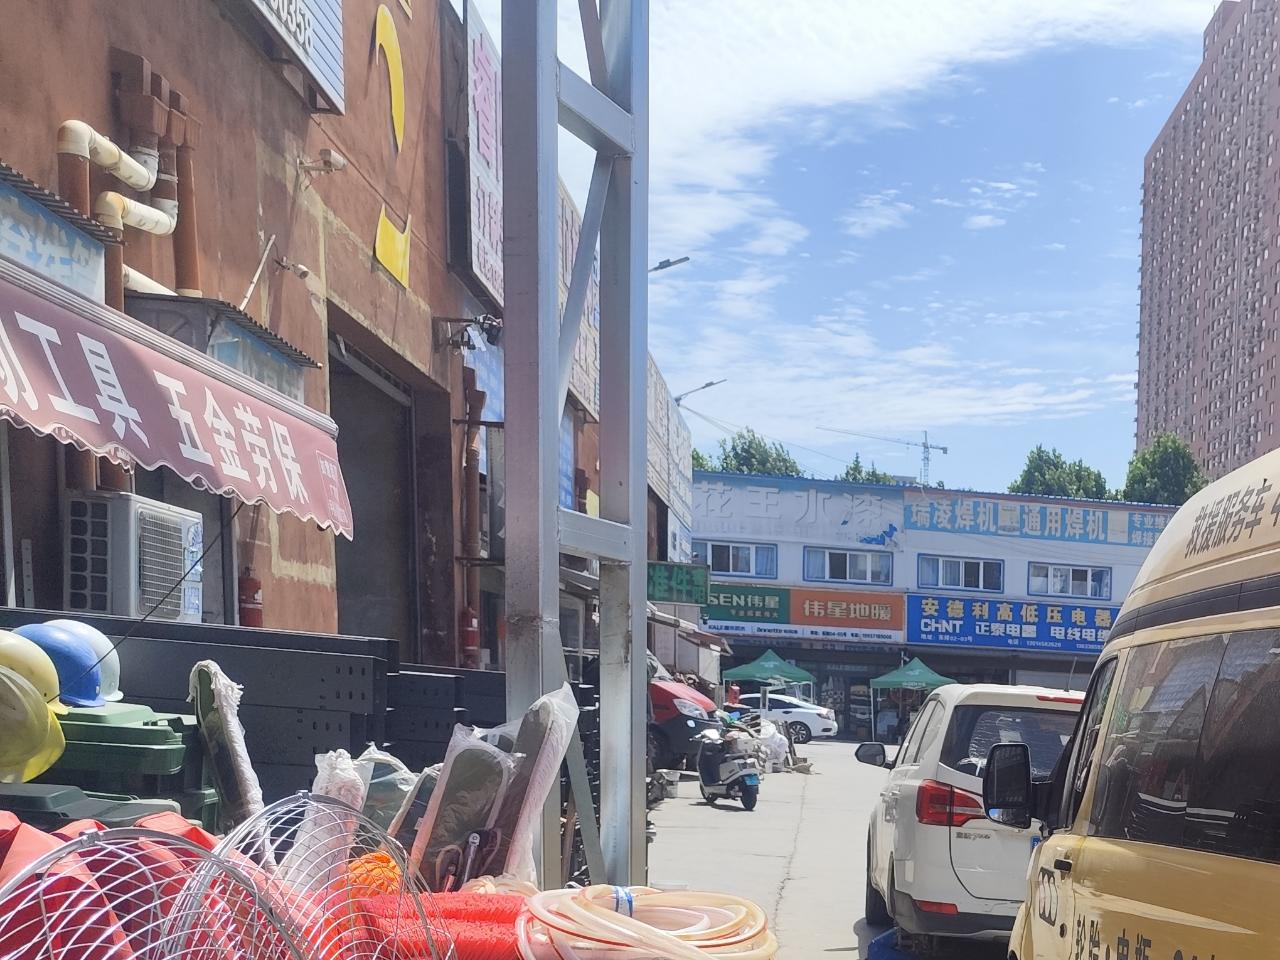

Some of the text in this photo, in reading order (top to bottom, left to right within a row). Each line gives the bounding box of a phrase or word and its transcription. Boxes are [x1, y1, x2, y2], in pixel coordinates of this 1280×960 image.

[270, 0, 313, 50] 0358
[153, 370, 309, 504] 五金劳保
[911, 499, 1106, 542] 瑞凌焊机 通用焊机
[1185, 482, 1272, 558] 救援服务车
[803, 599, 892, 621] 伟星地暖
[920, 618, 964, 634] CHNT
[975, 621, 1037, 639] 正泰电器
[921, 597, 1112, 628] 安德利高低压电器
